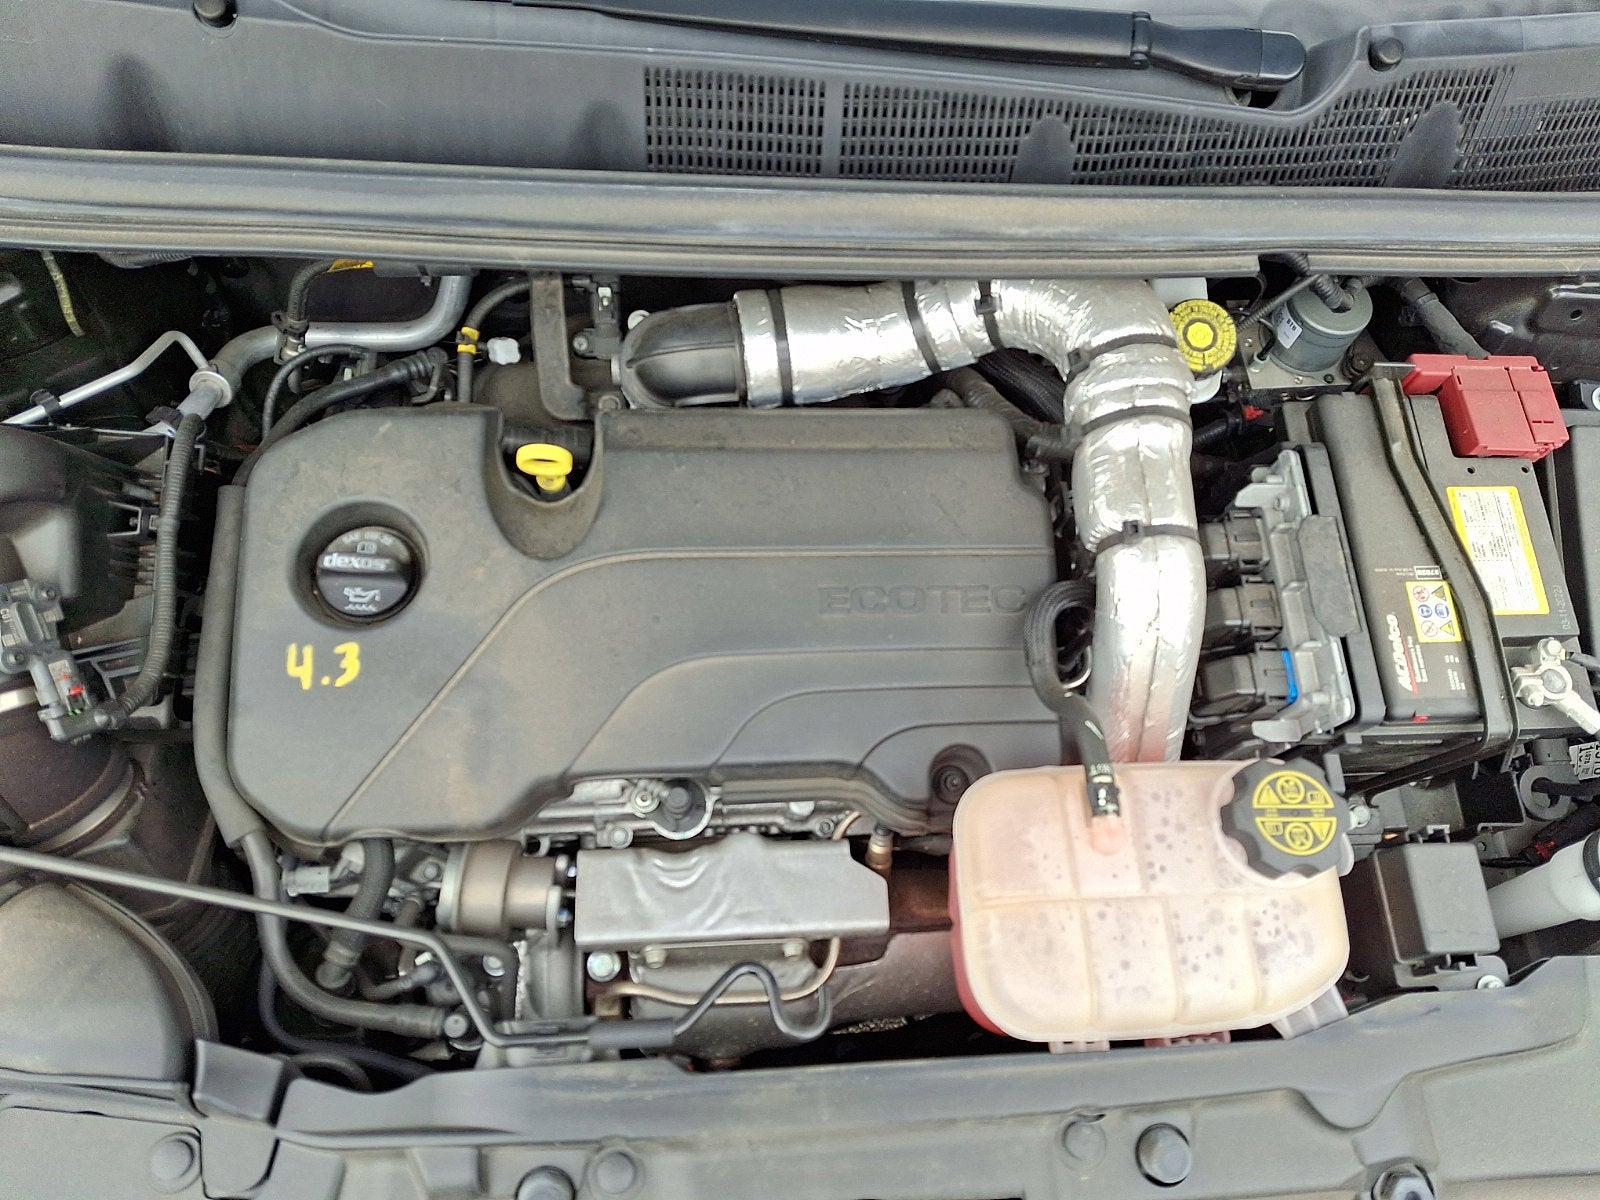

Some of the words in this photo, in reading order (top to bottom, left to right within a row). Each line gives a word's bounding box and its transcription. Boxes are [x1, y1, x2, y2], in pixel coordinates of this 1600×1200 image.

[323, 552, 388, 571] dexos
[816, 584, 1027, 614] ECOTEC
[286, 642, 361, 691] 4.3
[1386, 614, 1414, 692] ACDelco
